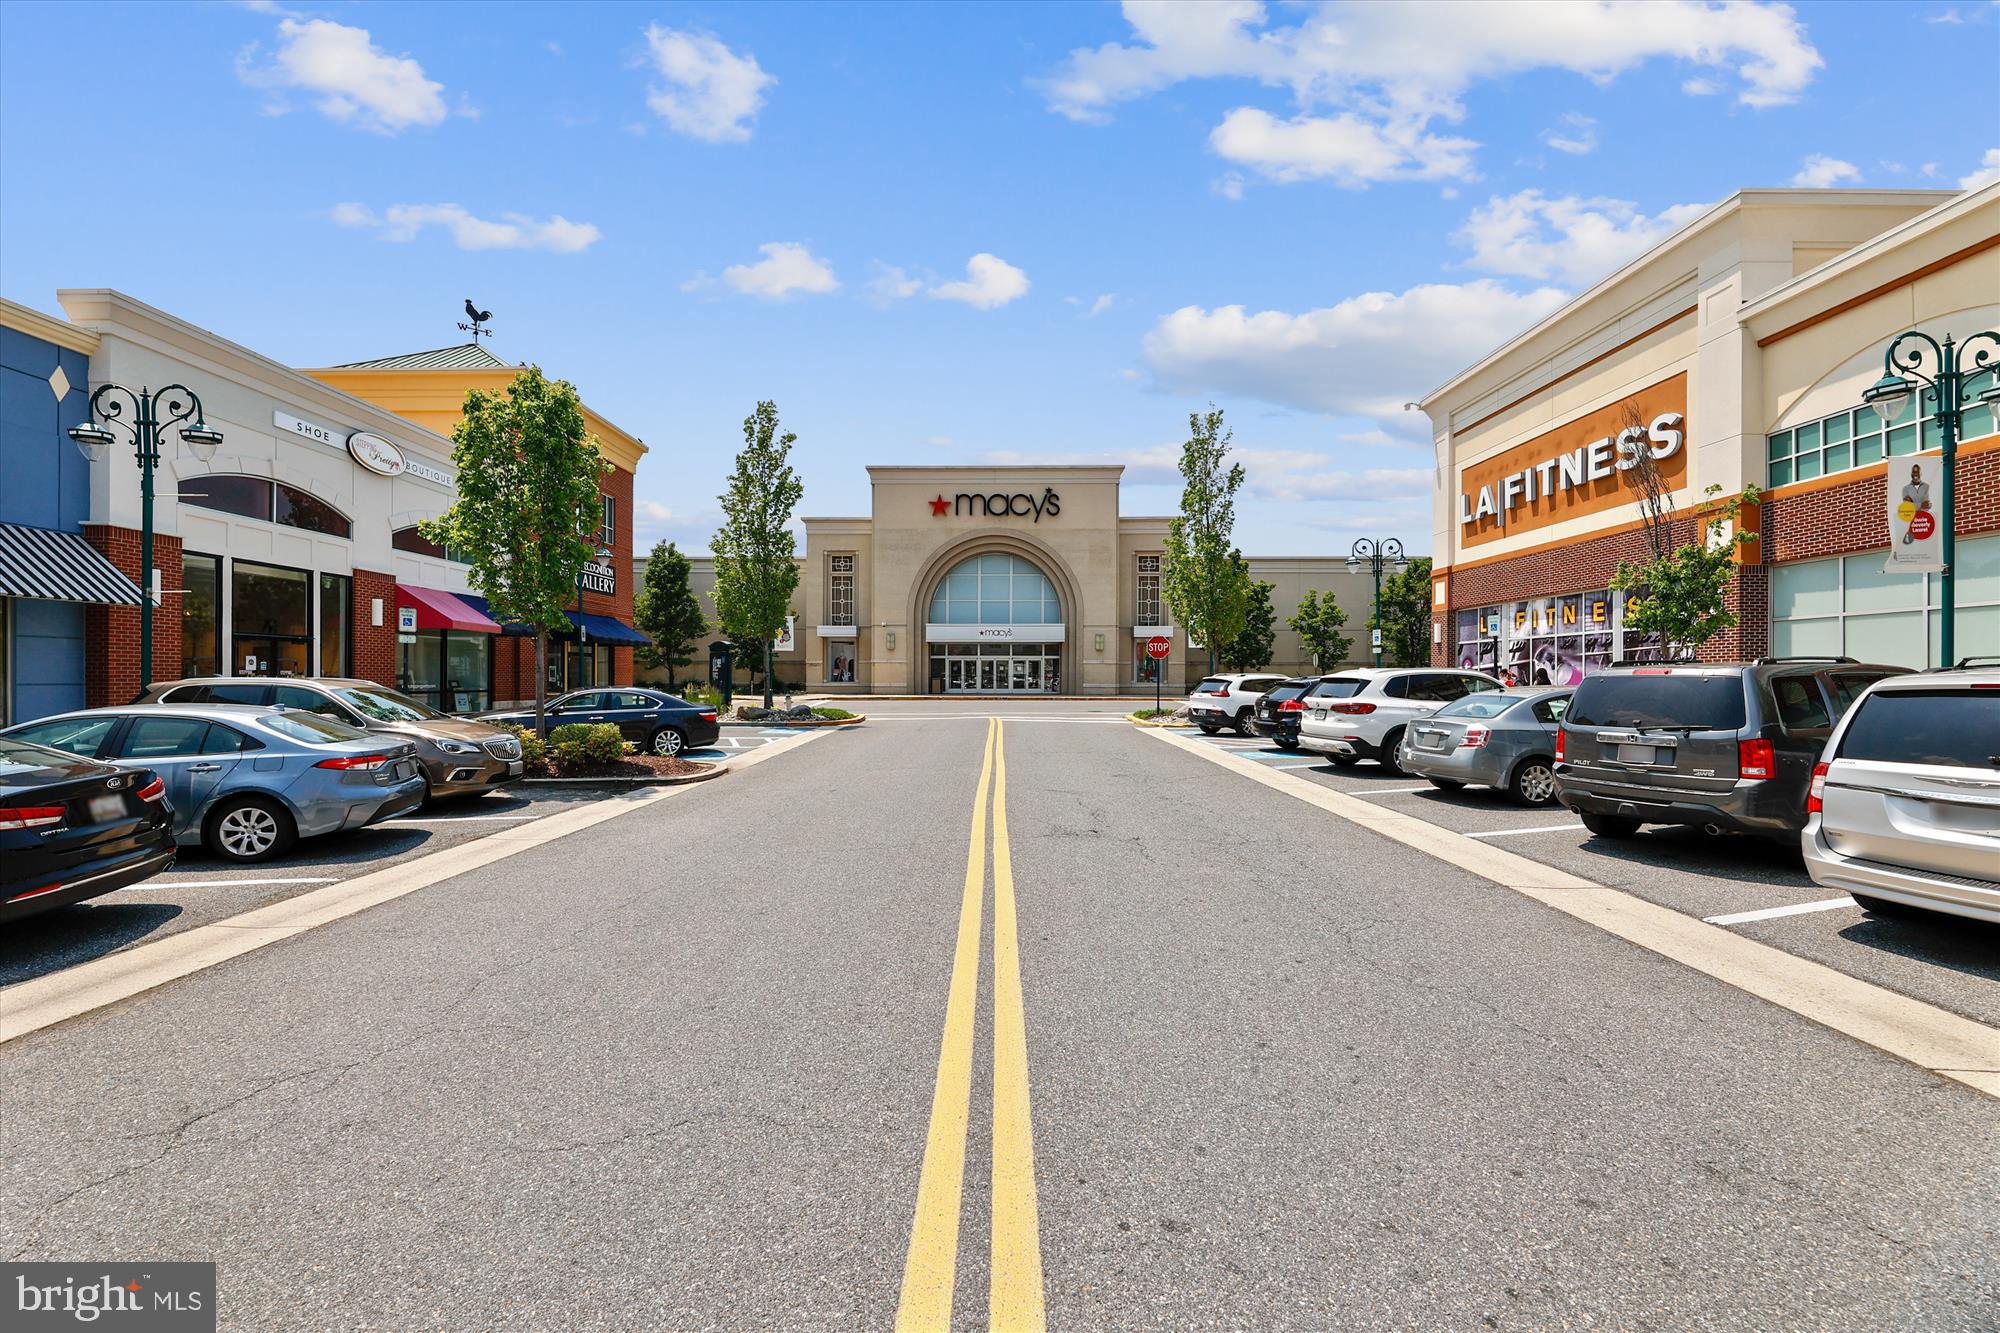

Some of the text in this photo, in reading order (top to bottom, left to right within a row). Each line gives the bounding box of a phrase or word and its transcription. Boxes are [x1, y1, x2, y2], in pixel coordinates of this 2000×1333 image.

[296, 422, 330, 442] SHOE
[405, 461, 451, 485] BOUTIQUE
[1460, 412, 1684, 524] LA FITNESS
[955, 486, 1061, 524] macy's
[584, 561, 613, 577] ECOGNITION
[984, 628, 1013, 639] macy's
[1148, 643, 1169, 652] STOP
[40, 826, 69, 837] OPTIMA
